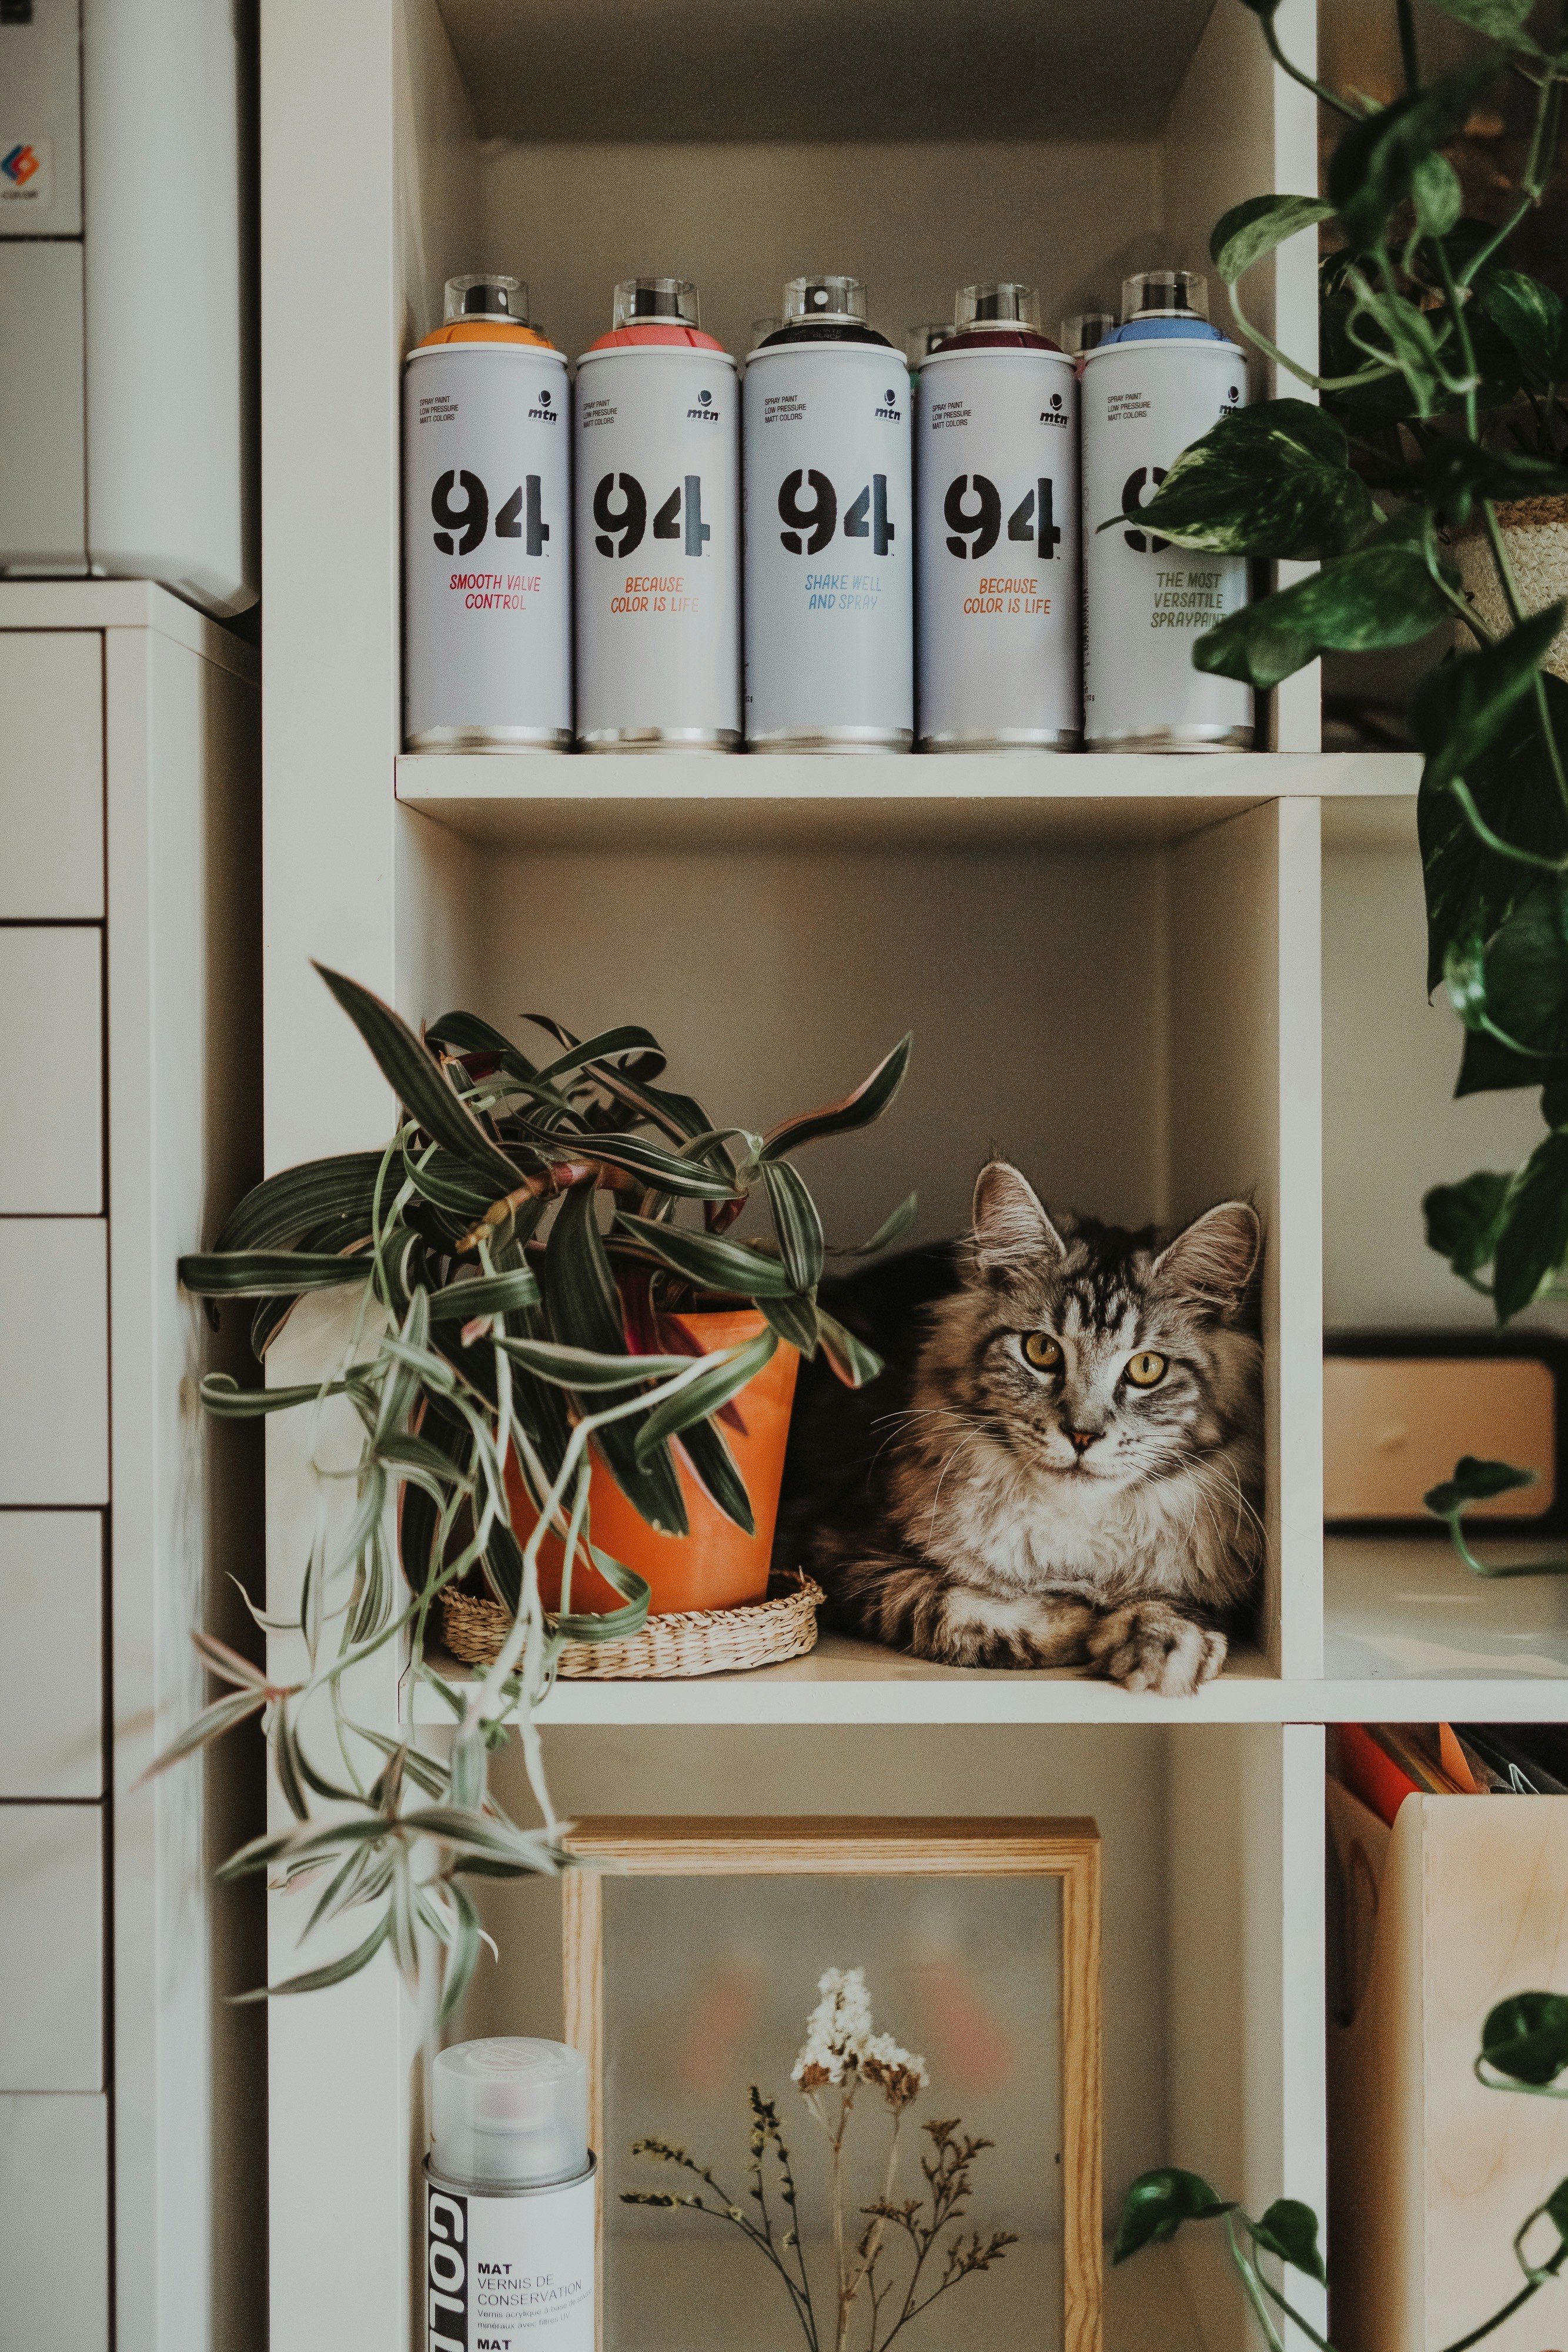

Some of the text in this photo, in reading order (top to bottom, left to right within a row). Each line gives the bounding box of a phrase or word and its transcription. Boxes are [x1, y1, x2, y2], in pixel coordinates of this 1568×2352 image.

[420, 397, 434, 406] SPRAY
[765, 397, 780, 405] SPRAY
[1108, 395, 1124, 403] SPRAY
[420, 405, 459, 415] LOW PRESSURE
[583, 402, 596, 410] SPRAY
[777, 404, 807, 412] PRESSURE
[932, 403, 947, 412] SPRAY
[1108, 401, 1151, 412] LOW PRESSURE
[528, 409, 557, 422] mtn
[583, 407, 617, 419] LOW PRESSURE
[687, 409, 718, 421] mtn
[765, 413, 803, 423] MATT COLORS
[875, 408, 901, 420] mtn
[932, 410, 972, 421] LOW PRESSURE
[1040, 412, 1068, 425] mtn
[1123, 410, 1146, 419] COLORS
[420, 416, 432, 424] MATT
[583, 417, 614, 428] MATT COLORS
[932, 419, 968, 430] MATT COLORS
[432, 470, 549, 556] 94
[593, 472, 710, 558] 94
[778, 469, 894, 556] 94
[944, 474, 1060, 560] 94
[450, 574, 541, 592] SMOOTH VALVE
[625, 577, 684, 593] BECAUSE
[805, 574, 881, 591] SHAKE WELL
[979, 578, 1038, 594] BECAUSE
[1156, 572, 1222, 588] THE MOST
[466, 594, 526, 610] CONTROL
[611, 597, 700, 613] COLOR IS LIFE
[809, 594, 878, 610] AND SPRAY
[964, 598, 1051, 614] COLOR IS LIFE
[1154, 592, 1223, 609] VERSATILE
[478, 2263, 512, 2274] MAT
[478, 2273, 554, 2290] VERNIS DE
[478, 2278, 581, 2306] CONSERVATION
[478, 2310, 503, 2318] Vernis
[560, 2311, 570, 2321] UV
[477, 2338, 511, 2351] MAT
